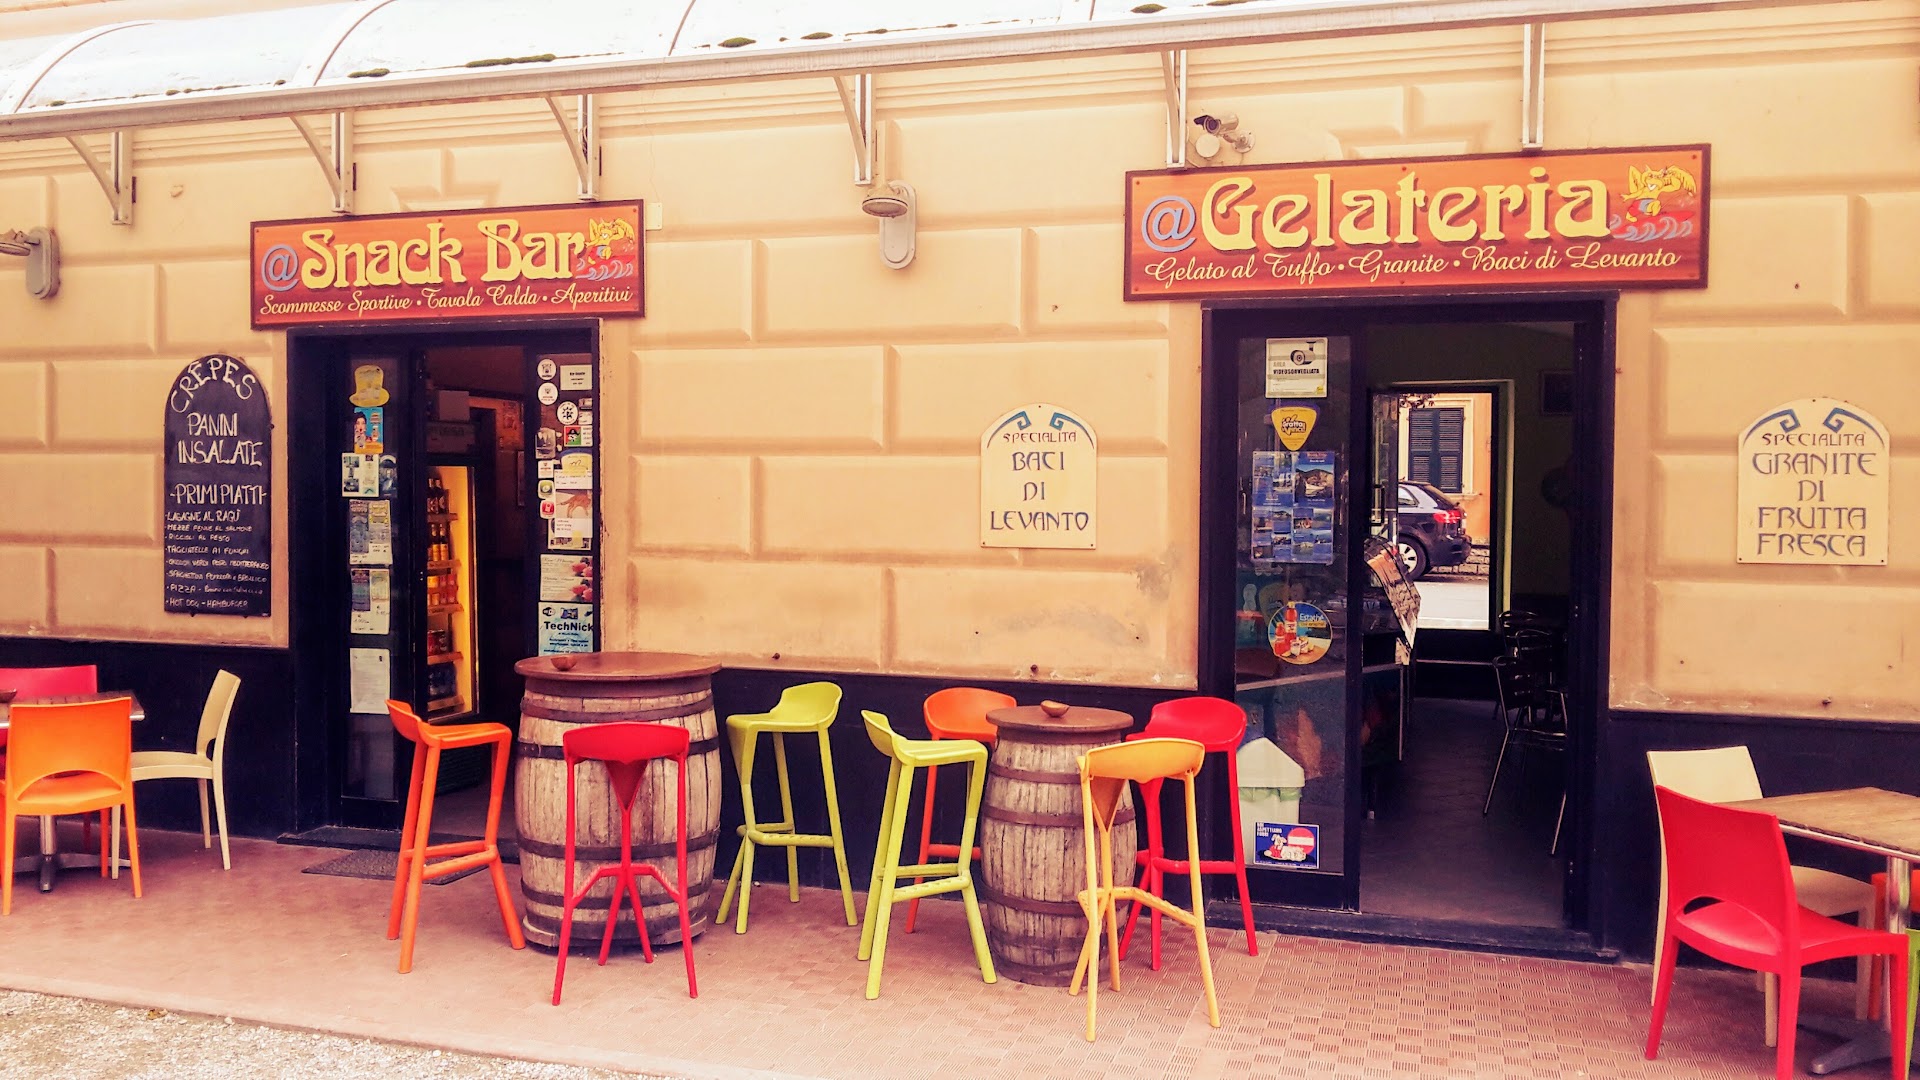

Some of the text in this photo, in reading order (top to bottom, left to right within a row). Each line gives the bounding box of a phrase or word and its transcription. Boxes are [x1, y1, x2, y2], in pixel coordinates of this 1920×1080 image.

[477, 219, 587, 282] Bar
[1144, 242, 1682, 288] Gelato al Tuffo Granite Baci di Levanto
[260, 283, 634, 317] Scommesse Sportive Tavola Calda Aperitivi
[187, 412, 238, 437] PANINI
[178, 440, 263, 467] INSALATE
[1012, 451, 1064, 471] BACI
[1752, 453, 1877, 477] GRANITE
[1023, 481, 1045, 501] DI
[1798, 480, 1825, 502] DI
[203, 511, 214, 521] AL
[990, 511, 1089, 531] LEVANTO
[1758, 507, 1867, 530] FRUTTA
[1757, 533, 1866, 557] FRESCA
[170, 584, 196, 594] PIZZA
[169, 598, 185, 607] HOT
[186, 599, 199, 608] DOG
[544, 621, 594, 631] TechNick
